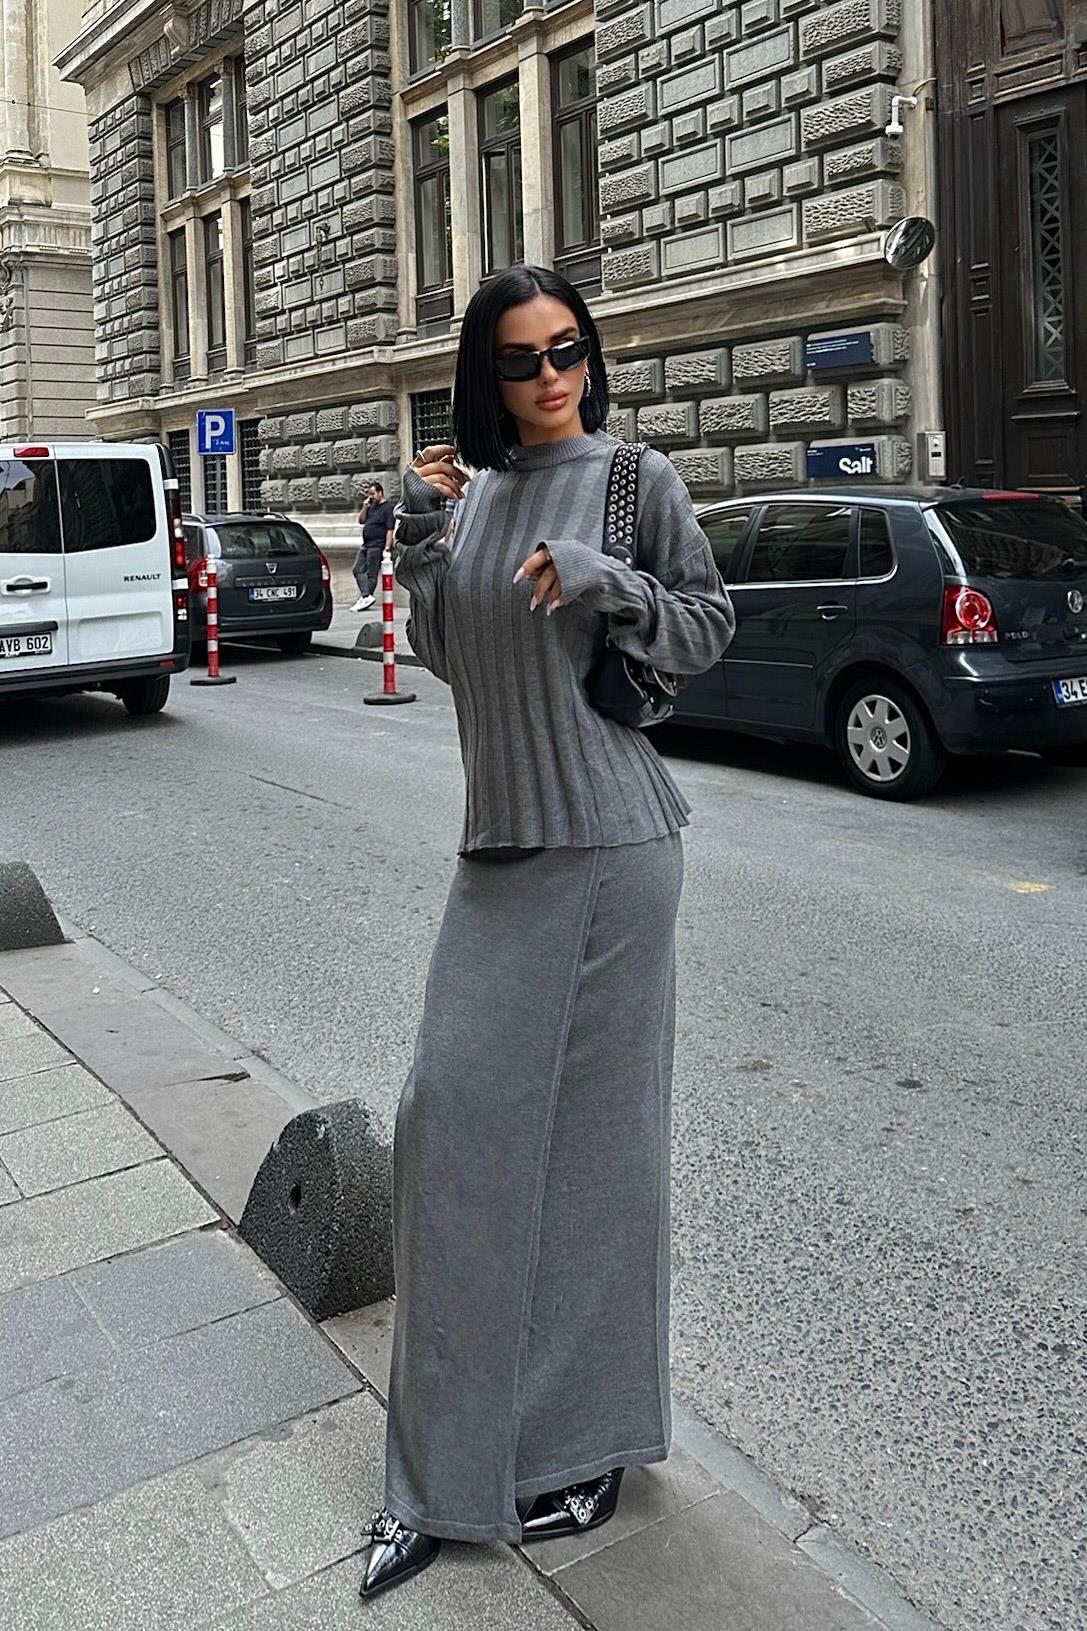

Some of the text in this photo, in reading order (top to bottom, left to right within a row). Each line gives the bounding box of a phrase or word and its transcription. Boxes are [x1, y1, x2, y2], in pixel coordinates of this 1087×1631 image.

[205, 415, 225, 449] P
[839, 456, 873, 474] Salt
[123, 573, 161, 582] RENAULT
[255, 589, 263, 598] 34
[0, 636, 49, 652] AVB 602
[1062, 678, 1087, 700] 34 E
